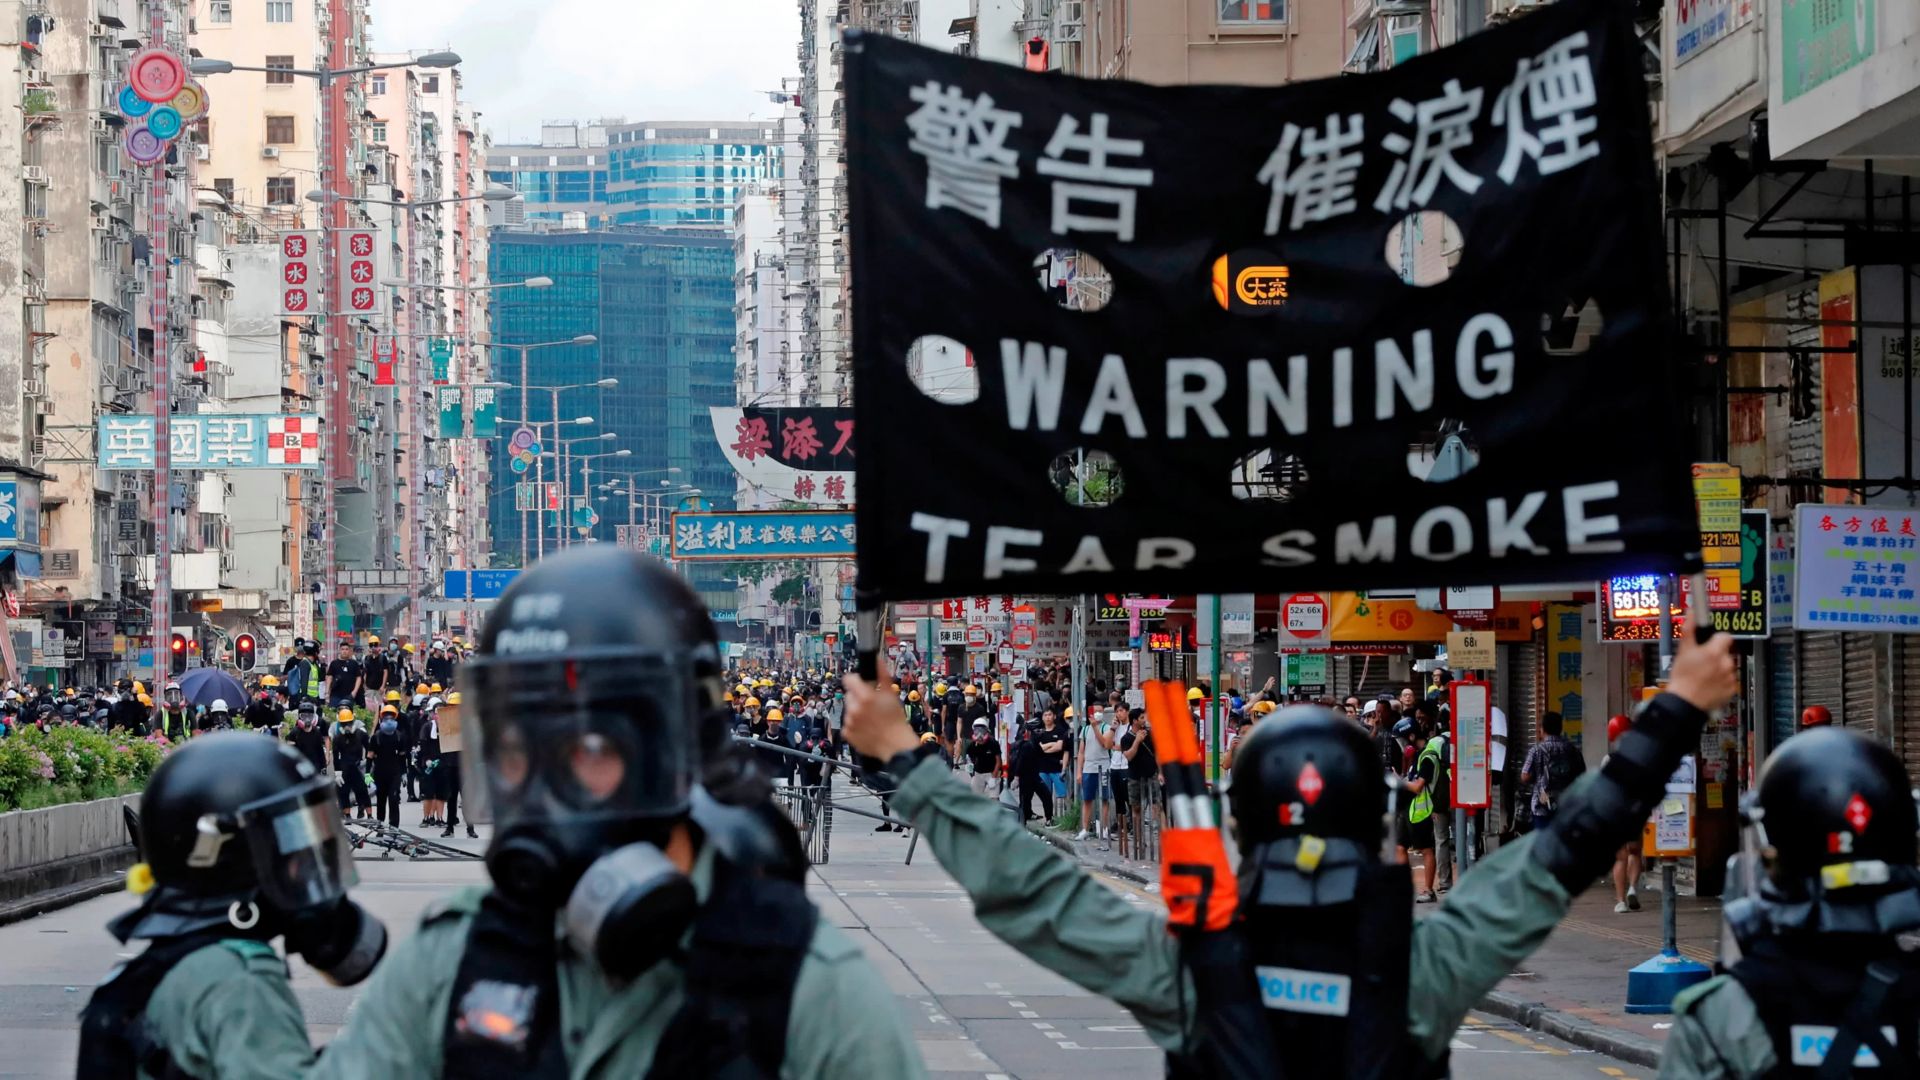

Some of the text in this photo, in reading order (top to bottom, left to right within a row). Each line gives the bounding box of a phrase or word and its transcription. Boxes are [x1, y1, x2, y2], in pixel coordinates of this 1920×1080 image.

[906, 81, 1154, 242] 警告
[1257, 30, 1599, 235] 催淚煙
[1001, 312, 1514, 438] WARNING
[474, 403, 485, 412] PO
[794, 475, 846, 500] 特種
[1262, 480, 1626, 566] SMOKE
[1290, 606, 1321, 614] 52x 66x
[1613, 591, 1659, 609] 56158
[1290, 619, 1303, 627] 67x
[1732, 611, 1763, 631] 6625
[1259, 975, 1340, 1005] POLICE
